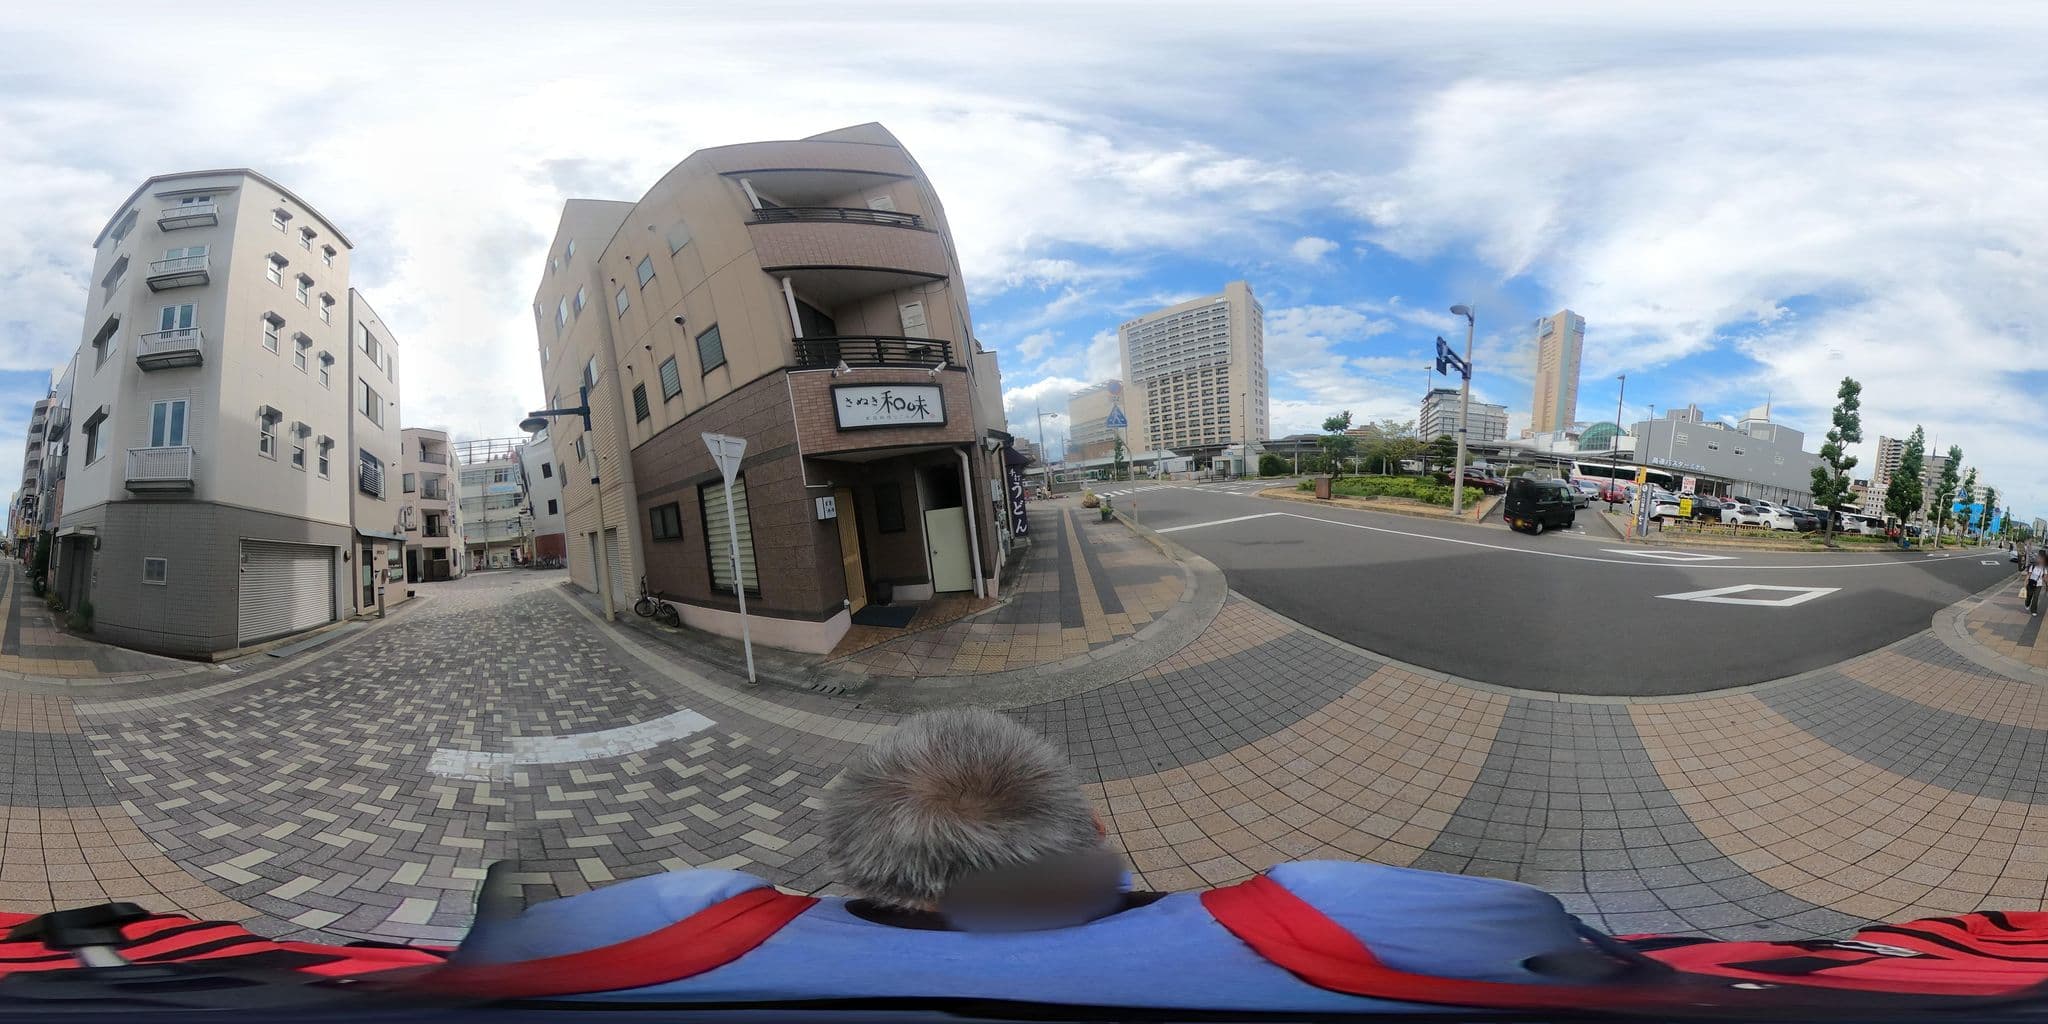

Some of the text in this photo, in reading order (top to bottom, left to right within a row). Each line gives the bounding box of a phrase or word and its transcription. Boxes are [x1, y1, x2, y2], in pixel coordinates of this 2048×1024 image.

[845, 390, 930, 420] さぬき和味
